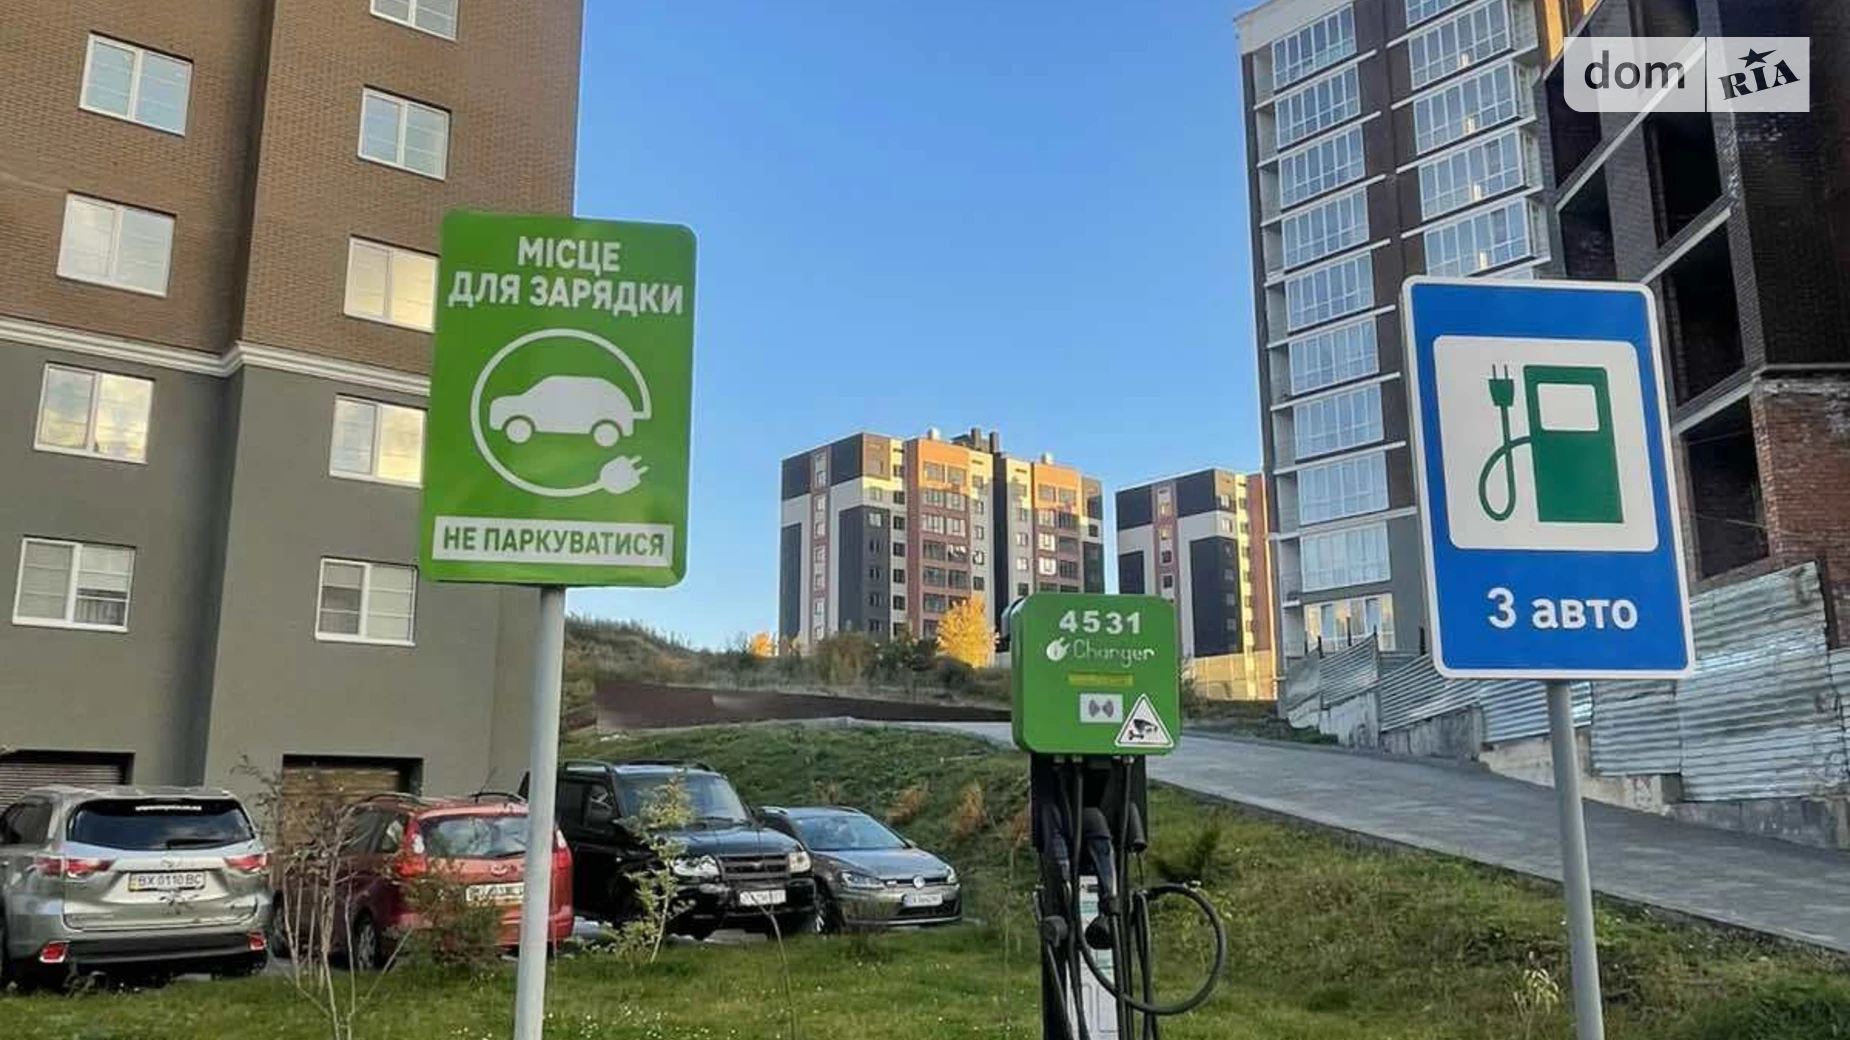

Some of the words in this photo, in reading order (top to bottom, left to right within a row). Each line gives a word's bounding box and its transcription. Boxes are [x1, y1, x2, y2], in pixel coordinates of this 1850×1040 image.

[517, 236, 621, 276] МІСЦЕ
[448, 270, 520, 308] ДЛЯ
[529, 276, 684, 318] ЗАРЯДКИ
[443, 526, 477, 551] НЕ
[484, 528, 665, 557] ПАРКУВАТИСЯ
[1058, 610, 1141, 634] 4531
[1487, 587, 1517, 629] 3
[1532, 598, 1638, 630] авто
